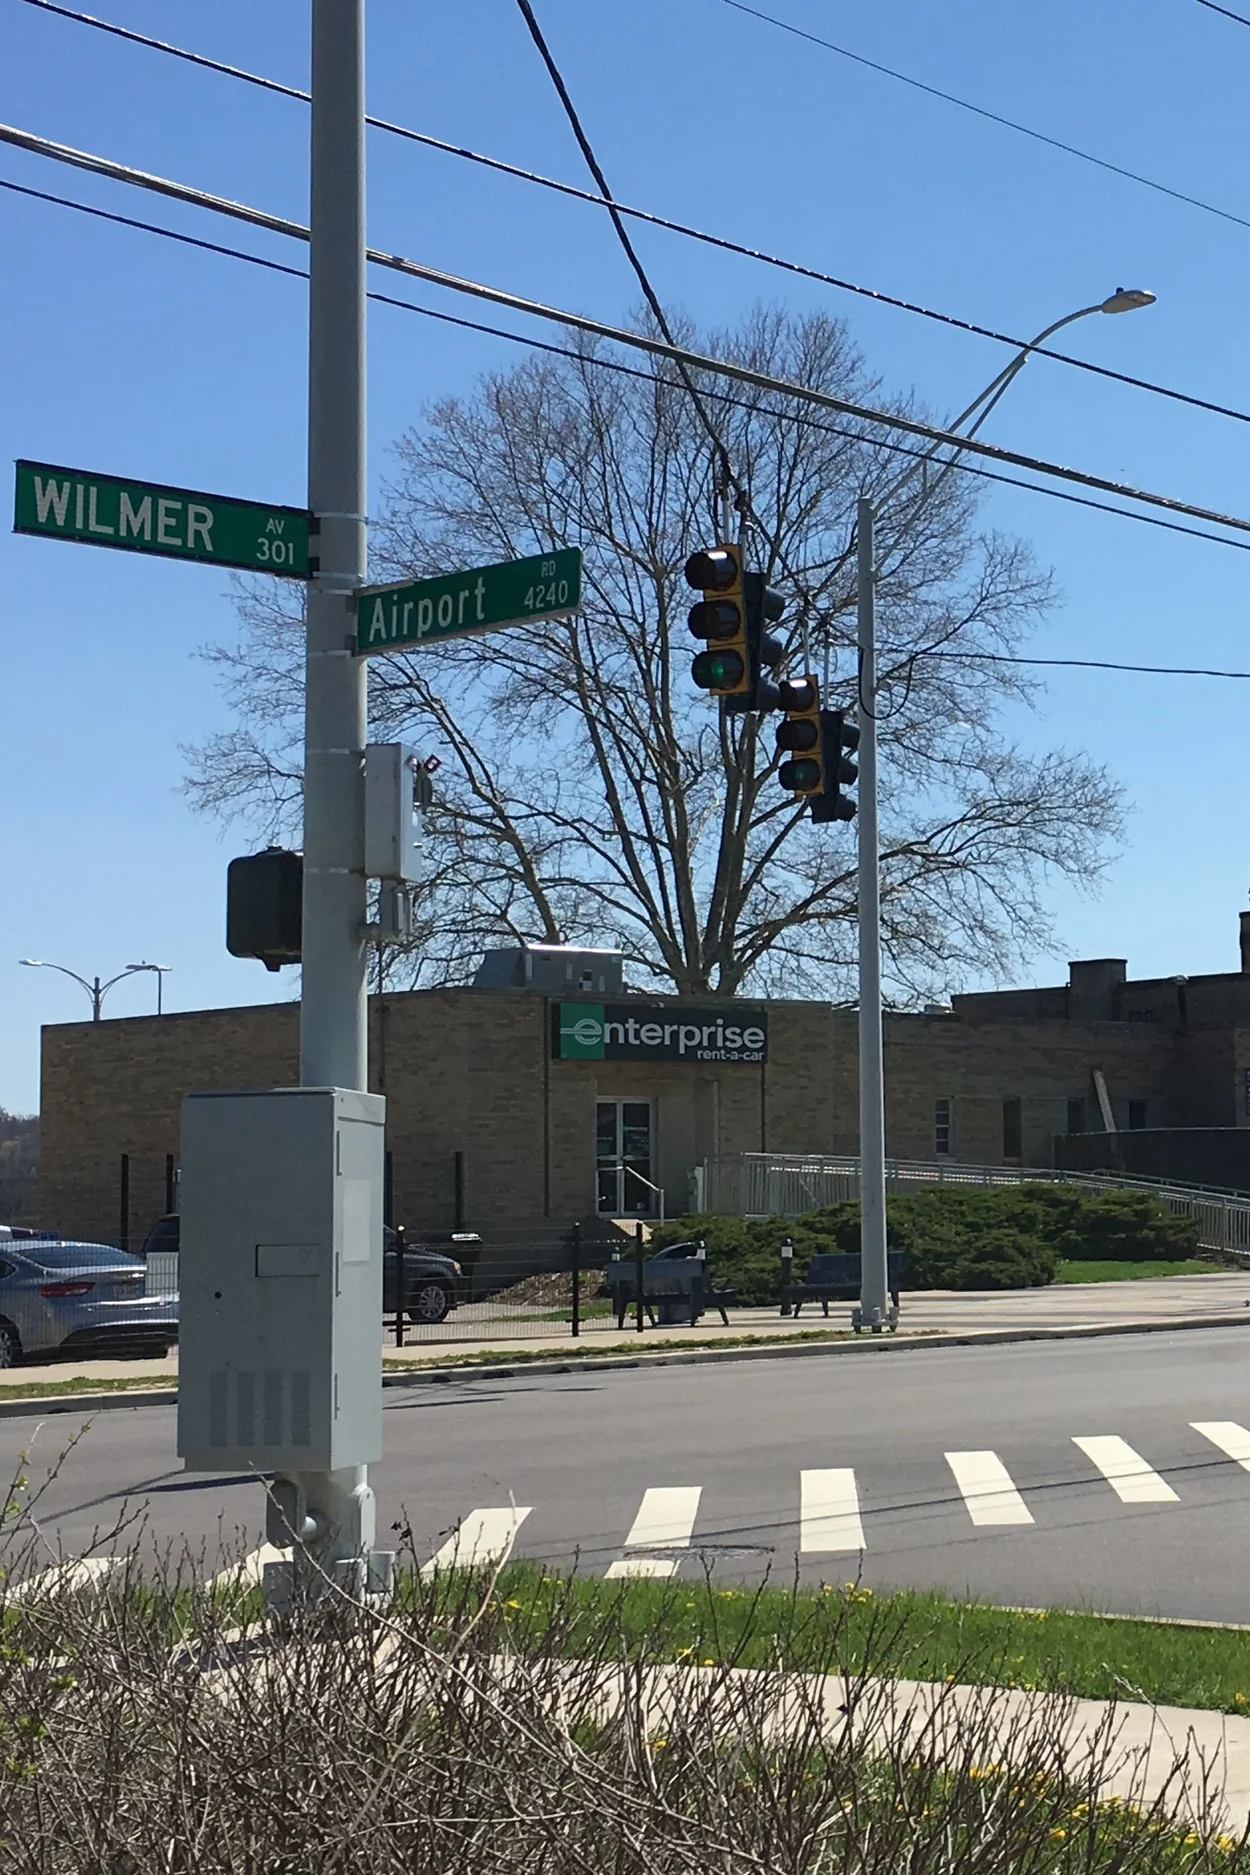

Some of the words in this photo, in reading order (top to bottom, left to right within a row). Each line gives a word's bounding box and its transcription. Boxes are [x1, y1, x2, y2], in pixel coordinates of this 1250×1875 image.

[33, 475, 215, 552] WILMER
[265, 517, 286, 536] AV
[256, 536, 295, 566] 301
[541, 560, 557, 578] RD
[368, 576, 487, 643] Airport
[523, 582, 569, 611] 4240
[560, 1018, 765, 1054] enterprise
[697, 1049, 765, 1061] rent-a-car
